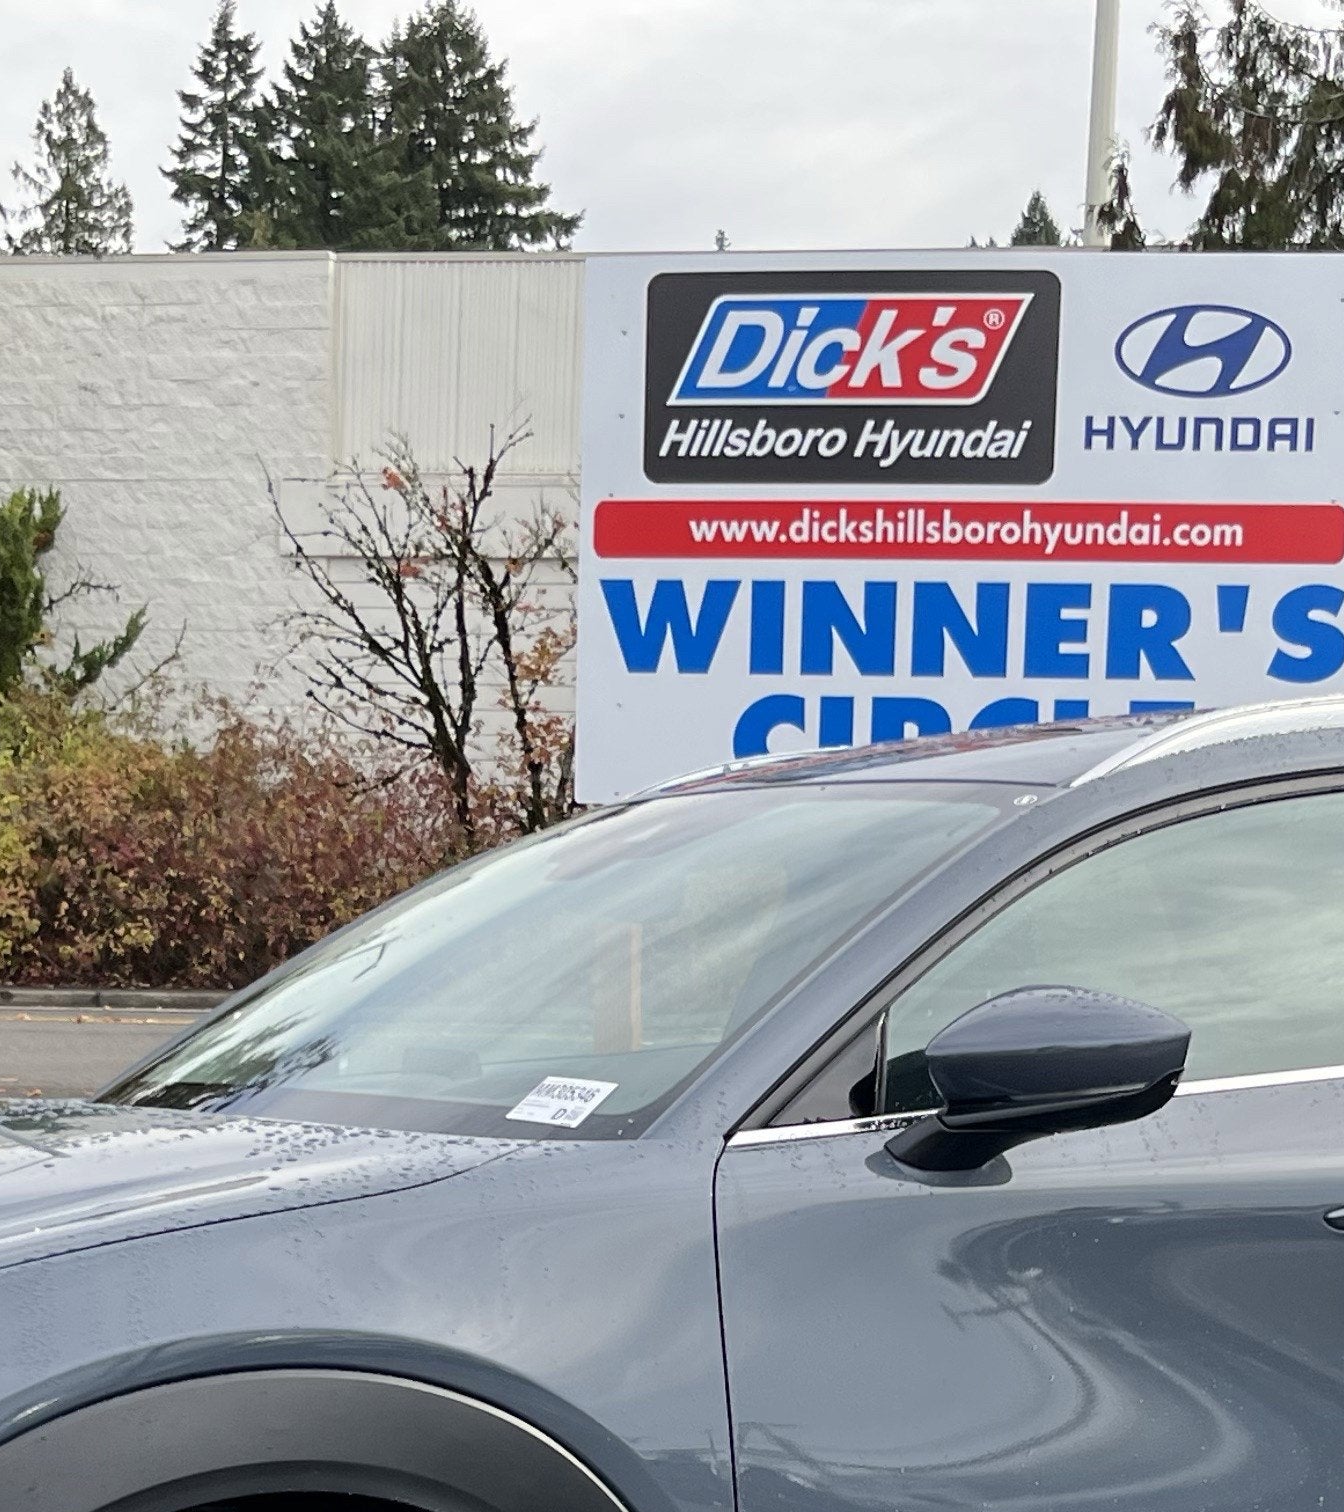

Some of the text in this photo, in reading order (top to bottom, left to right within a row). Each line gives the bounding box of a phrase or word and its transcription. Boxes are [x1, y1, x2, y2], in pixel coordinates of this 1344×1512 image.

[659, 418, 1033, 468] Hillsboro Hyundai
[1084, 415, 1315, 453] HYUNDAI
[689, 509, 1244, 555] www.dickshillsborohyundai.com
